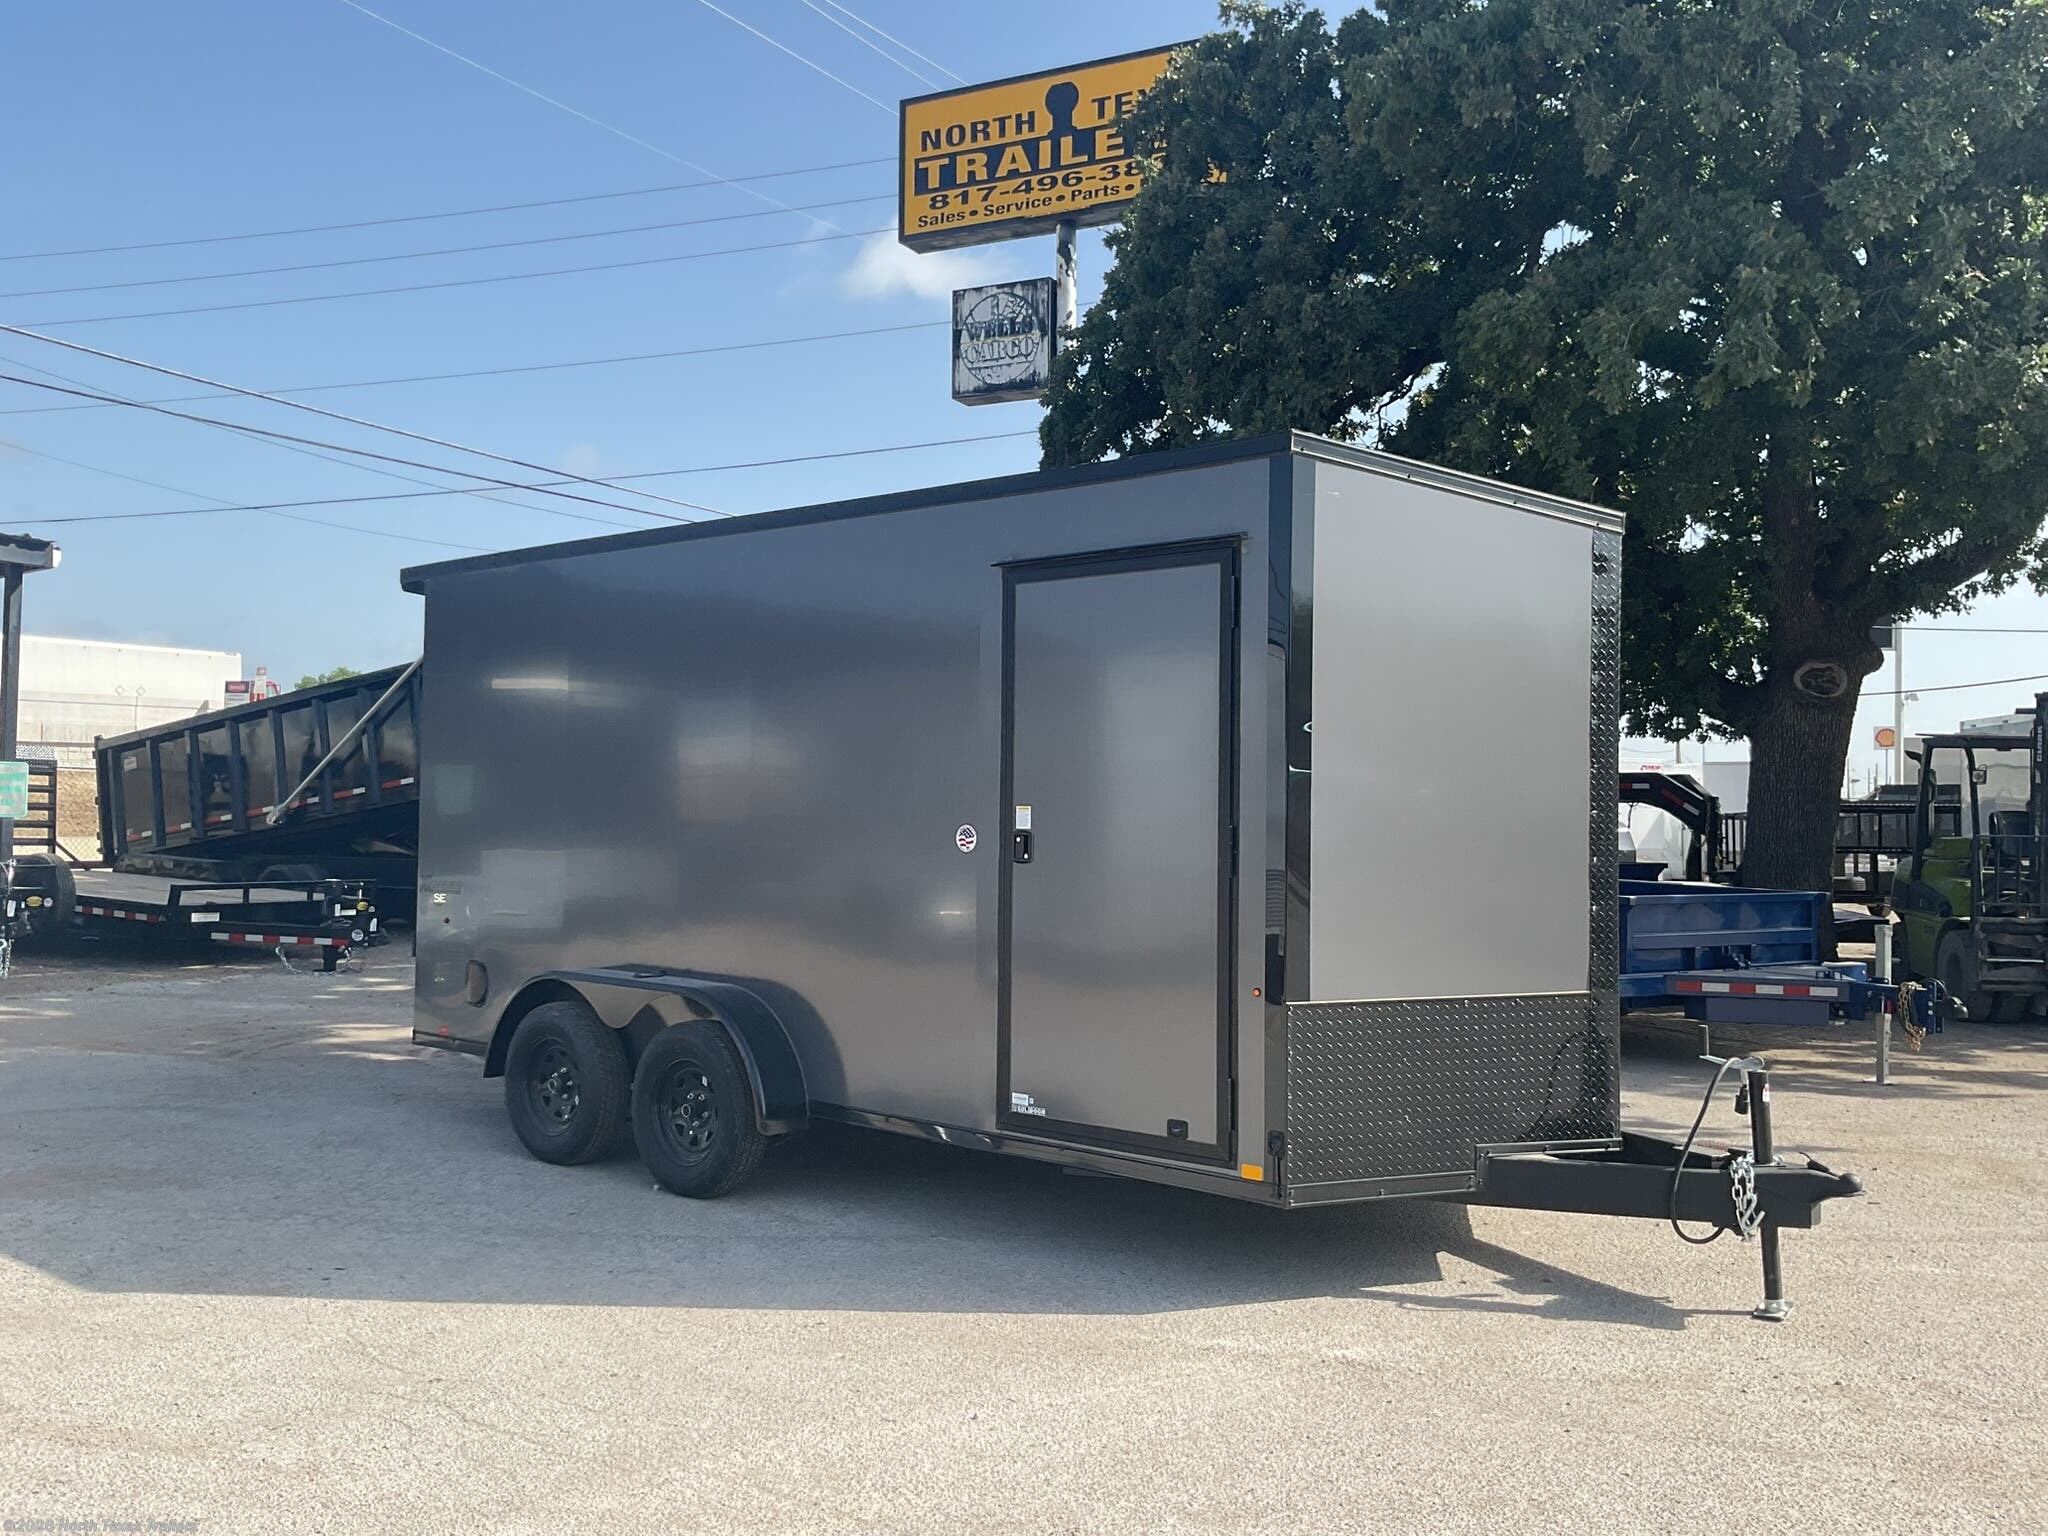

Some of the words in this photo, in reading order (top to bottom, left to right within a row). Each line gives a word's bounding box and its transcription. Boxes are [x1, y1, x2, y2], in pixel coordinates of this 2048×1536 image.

[920, 110, 1036, 152] NORTH
[918, 125, 1125, 190] TRAILE
[917, 210, 966, 228] Sales
[983, 196, 1053, 217] Service
[1070, 184, 1120, 202] Parts
[963, 335, 1036, 364] CARGO
[433, 892, 447, 903] SE
